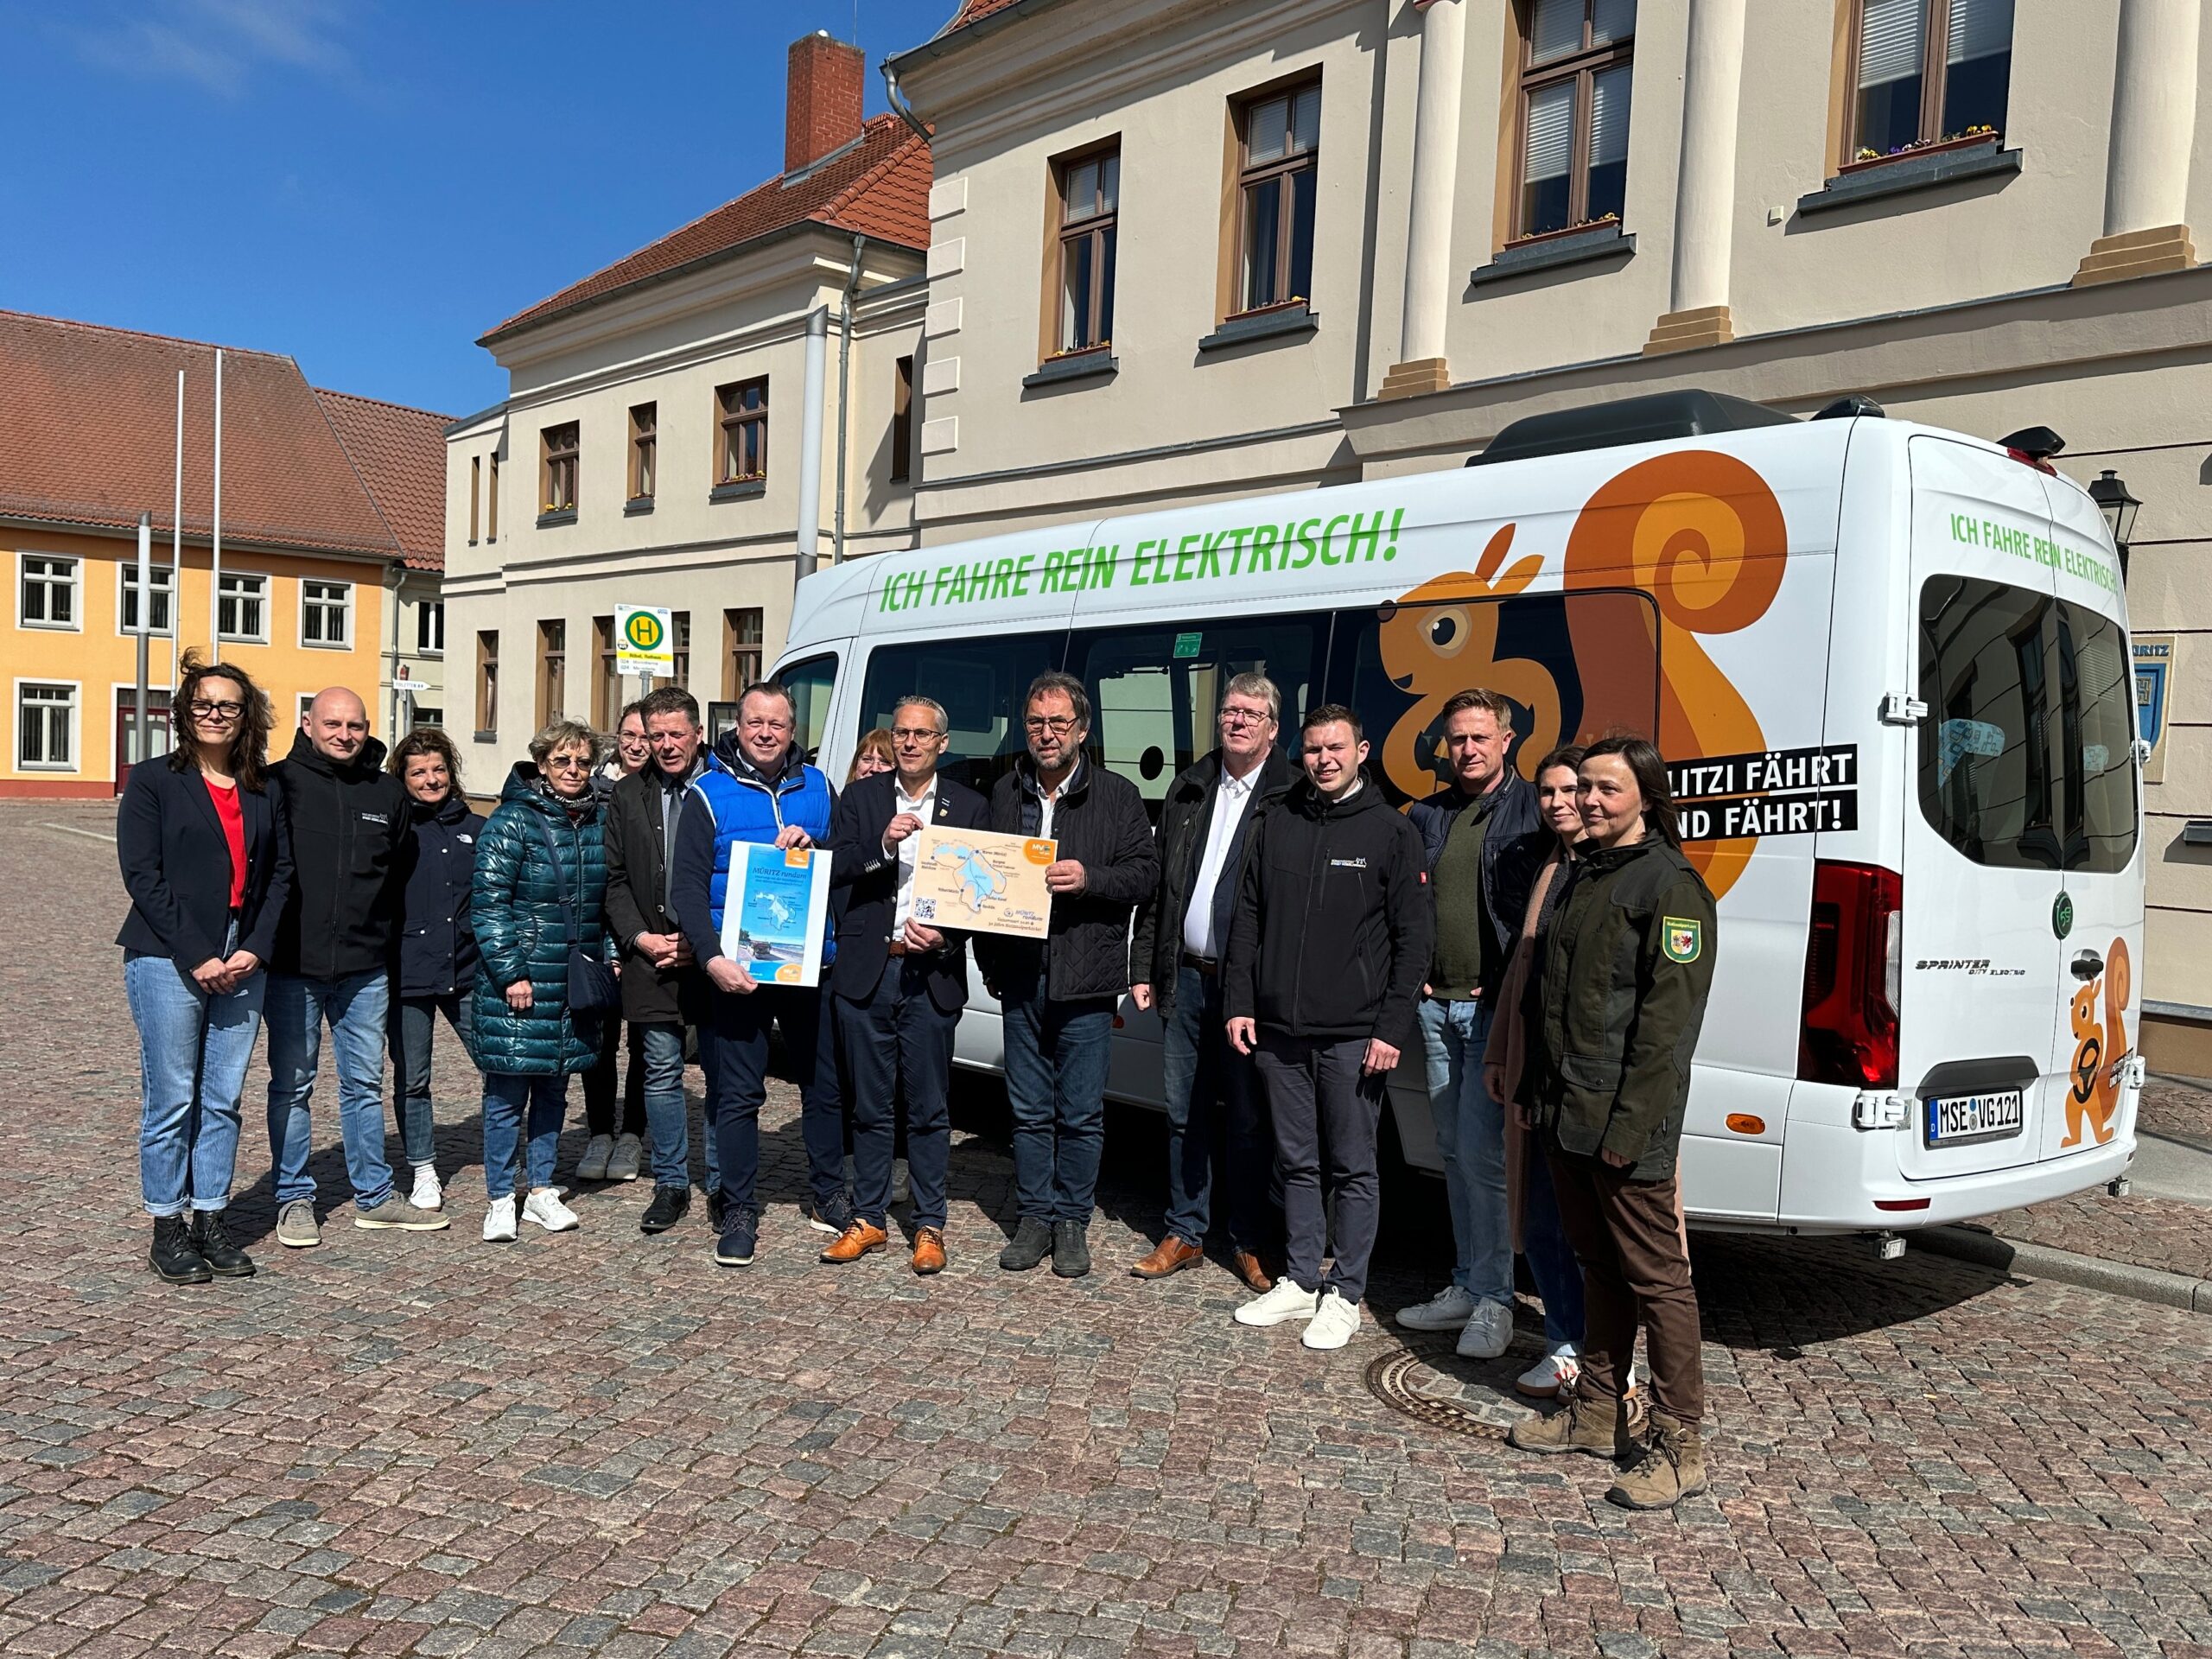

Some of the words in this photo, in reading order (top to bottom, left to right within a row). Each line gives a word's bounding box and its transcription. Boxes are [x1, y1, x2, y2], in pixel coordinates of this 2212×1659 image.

[879, 570, 924, 613] ICH
[931, 555, 1035, 604] FAHRE
[1039, 544, 1120, 593] REIN
[1129, 508, 1405, 586] ELEKTRISCH!
[1950, 513, 1979, 545] ICH
[1983, 521, 2031, 560] FAHRE
[2034, 537, 2062, 569] REIN
[2064, 547, 2118, 596] ELEKTRISCH!
[636, 620, 653, 642] H
[1667, 765, 1733, 798] LITZI
[1746, 753, 1853, 791] FÄHRT
[1677, 810, 1710, 839] ND
[1726, 798, 1841, 836] FÄHRT!
[1915, 959, 1991, 970] SPRINTER
[1940, 1101, 1967, 1134] MSE
